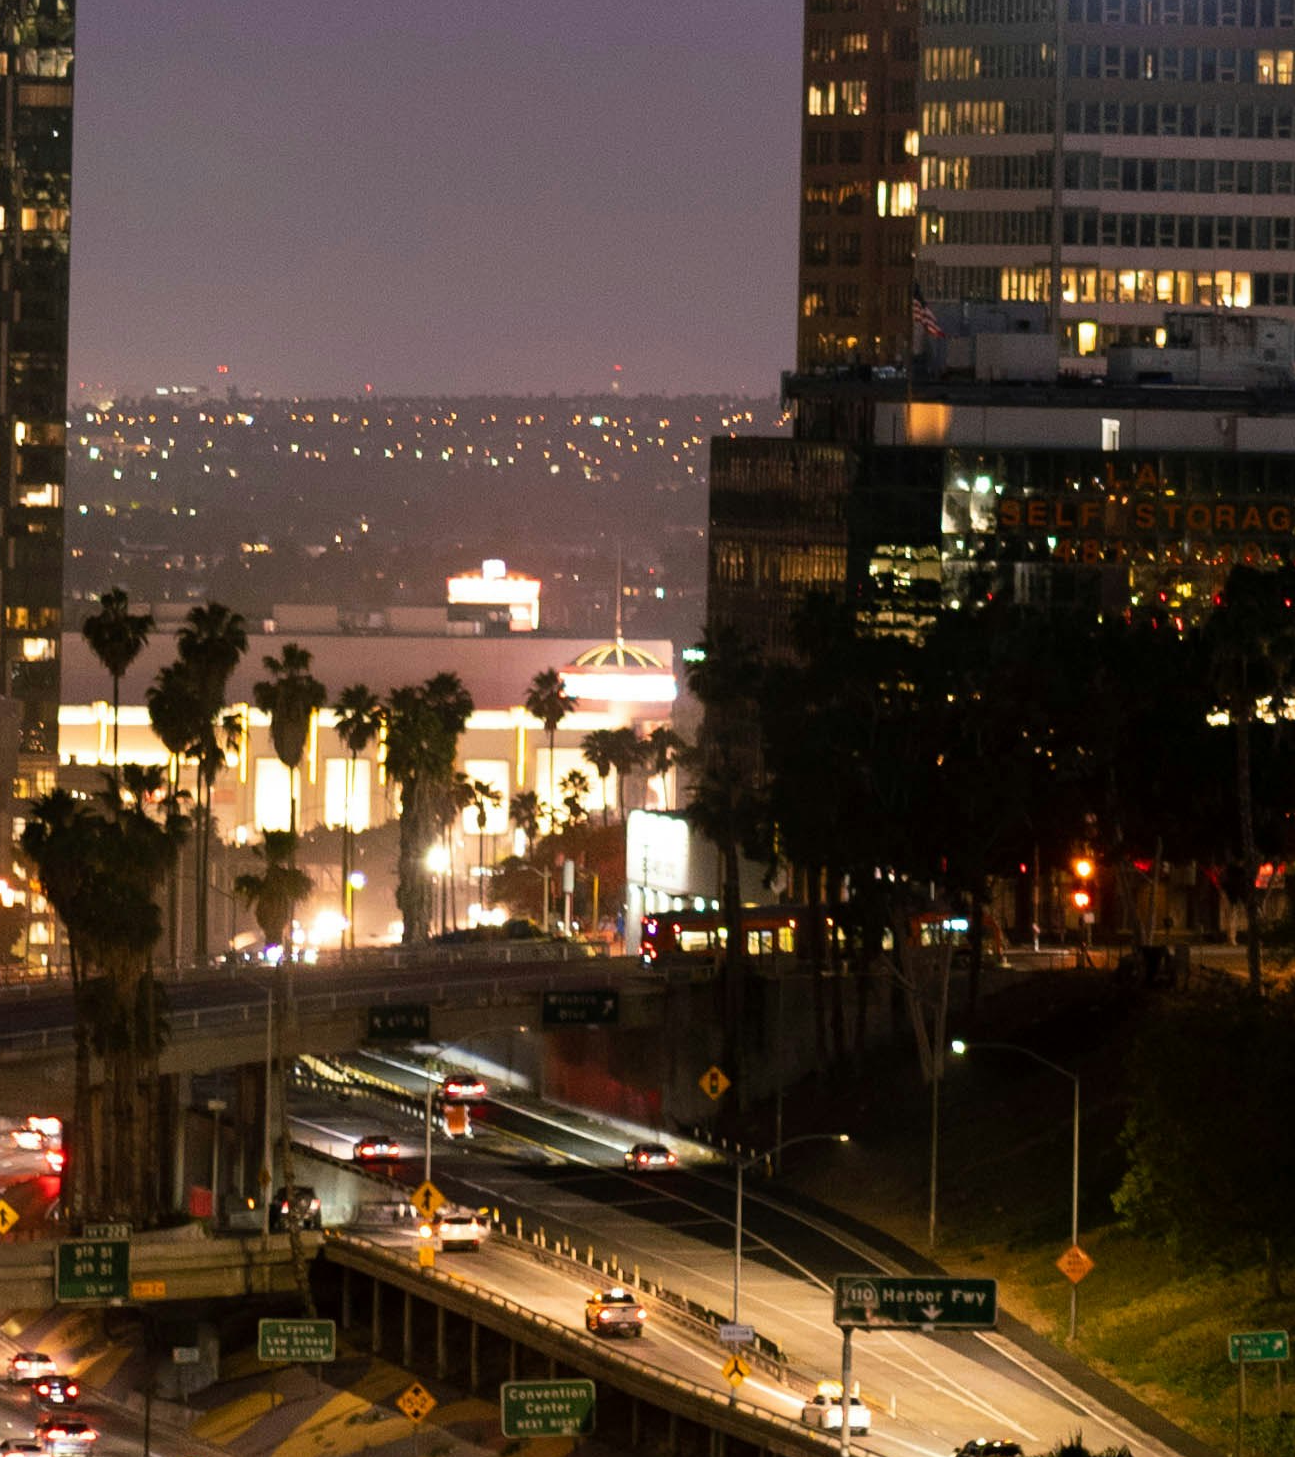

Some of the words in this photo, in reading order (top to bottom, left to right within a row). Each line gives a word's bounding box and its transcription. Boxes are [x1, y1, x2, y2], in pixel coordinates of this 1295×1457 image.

[1000, 498, 1102, 527] SELF
[850, 1288, 874, 1302] 110
[882, 1288, 944, 1303] Harbor
[952, 1289, 987, 1307] Fwy
[508, 1387, 588, 1401] Convention
[525, 1403, 572, 1415] Center
